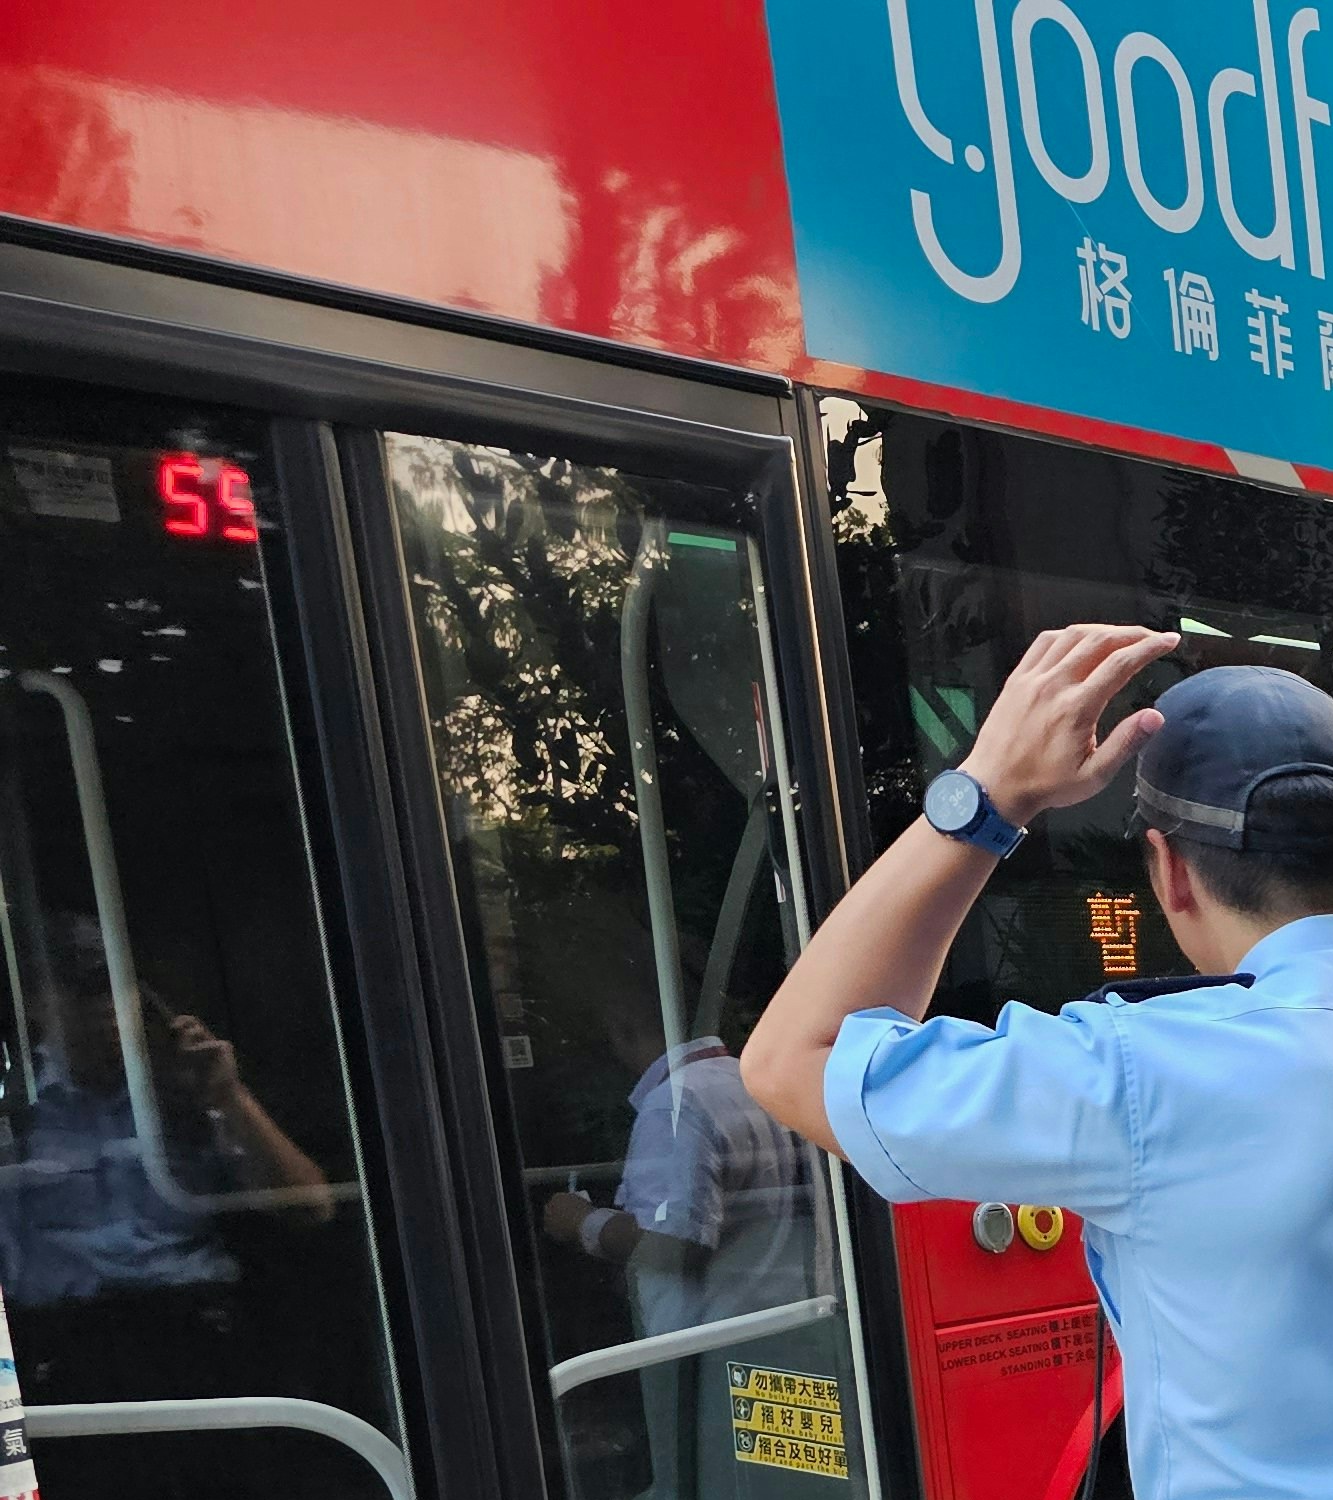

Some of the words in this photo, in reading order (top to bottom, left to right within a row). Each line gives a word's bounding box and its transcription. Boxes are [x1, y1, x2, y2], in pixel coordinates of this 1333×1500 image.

[938, 1338, 972, 1354] UPPER
[975, 1334, 1002, 1346] DECK
[1006, 1324, 1047, 1340] SEATING
[941, 1356, 978, 1371] LOWER
[979, 1351, 1007, 1363] DECK
[1008, 1343, 1050, 1358] SEATING
[1001, 1358, 1050, 1377] STANDING
[755, 1372, 839, 1401] 勿攜帶大型物
[755, 1389, 766, 1397] No
[769, 1392, 790, 1403] bulky
[794, 1397, 817, 1407] goods
[761, 1405, 843, 1434] 摺好嬰兒
[3, 1427, 27, 1457] 氣
[759, 1437, 847, 1468] 摺合及包好單
